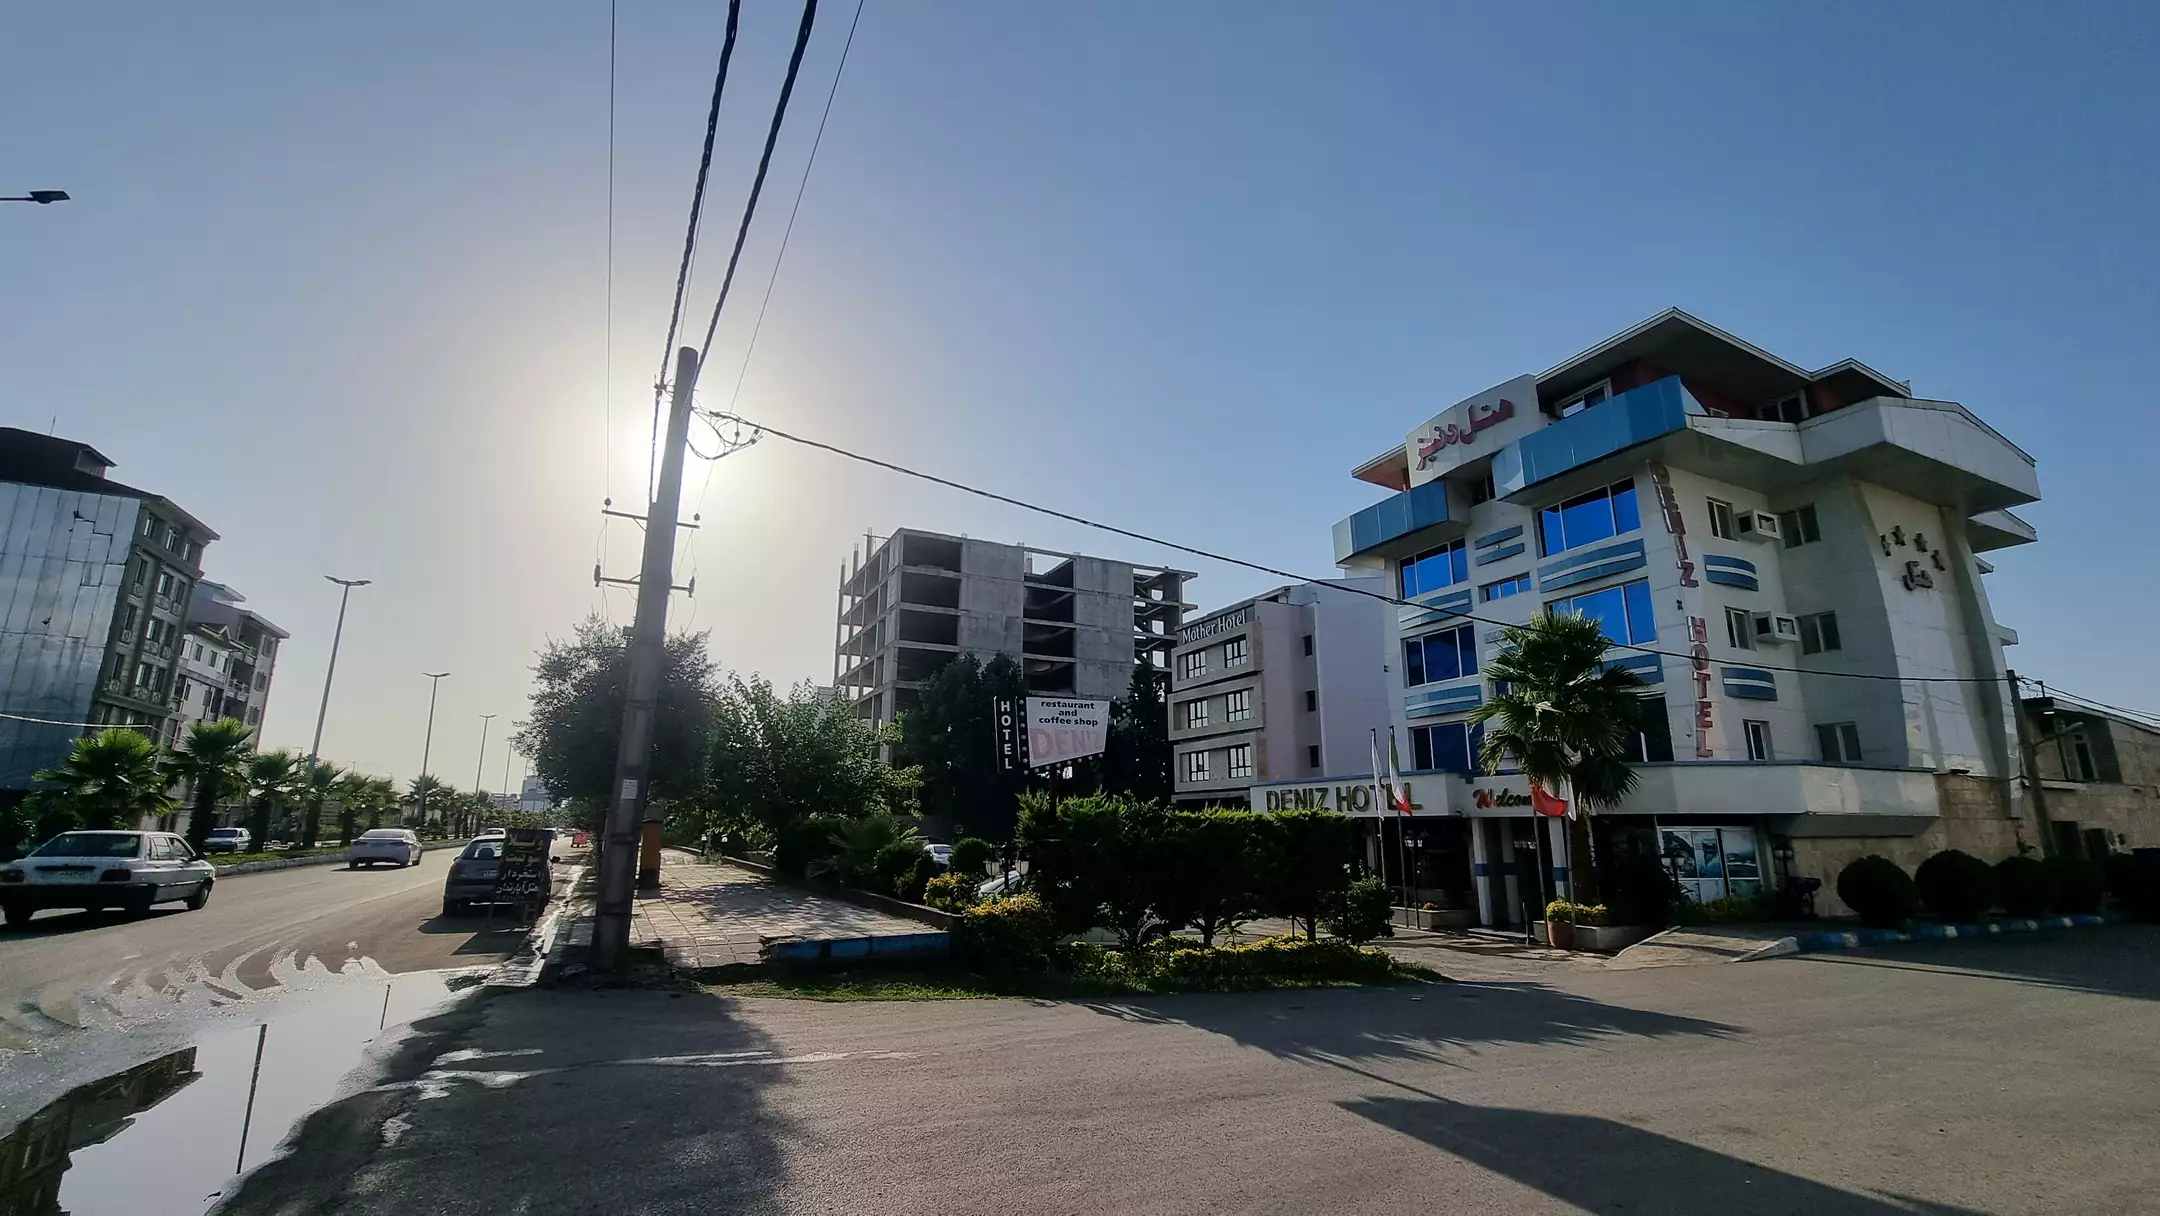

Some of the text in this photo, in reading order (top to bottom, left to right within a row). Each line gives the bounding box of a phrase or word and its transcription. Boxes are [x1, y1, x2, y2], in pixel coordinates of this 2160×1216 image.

[1459, 398, 1514, 445] هتل
[1649, 458, 1700, 588] DENIZ
[1182, 608, 1247, 645] Mother Hotel
[1686, 615, 1714, 758] HOTEL
[1040, 700, 1095, 710] restaurant
[1058, 709, 1078, 717] and
[1000, 700, 1013, 770] HOTEL
[1038, 717, 1099, 727] coffee shop
[1029, 728, 1103, 760] DENIZ
[1265, 787, 1331, 813] DENIZ
[1472, 787, 1533, 809] Welcom
